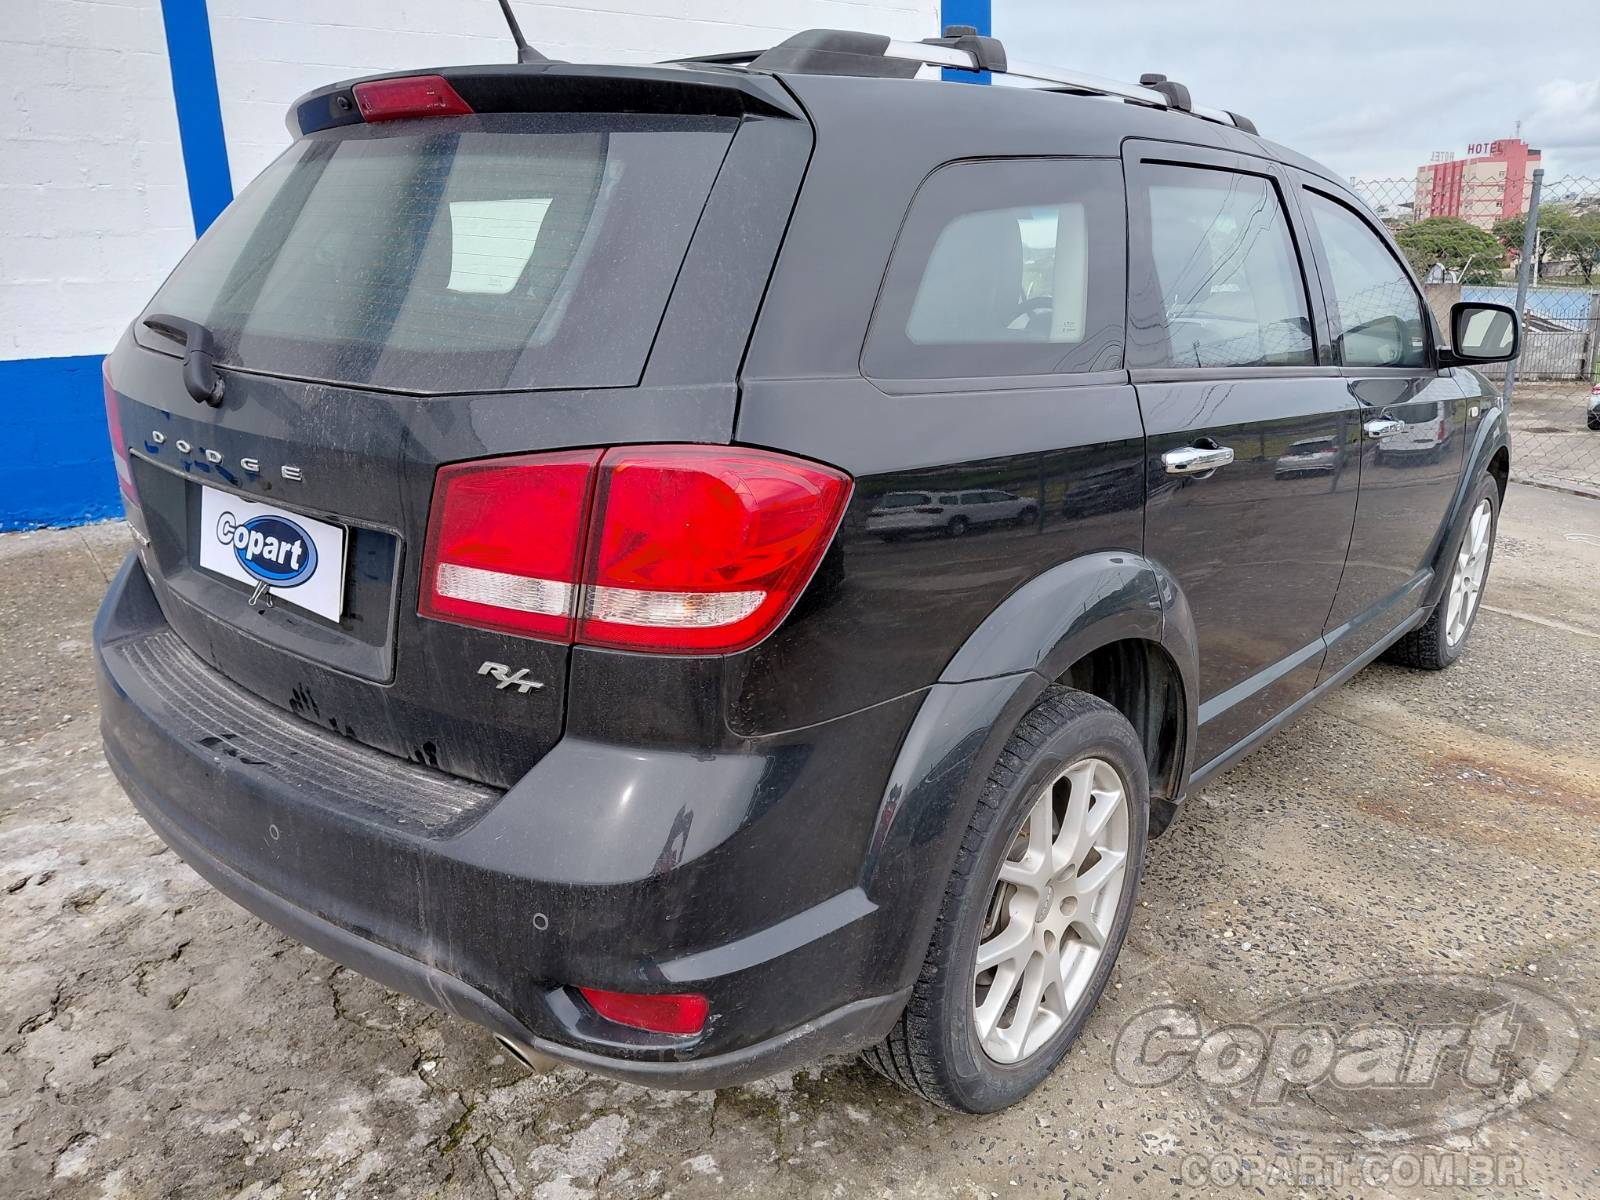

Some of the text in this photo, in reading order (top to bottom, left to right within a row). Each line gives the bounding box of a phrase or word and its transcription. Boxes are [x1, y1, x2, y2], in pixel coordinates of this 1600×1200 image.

[1467, 142, 1503, 155] HOTEL
[152, 430, 302, 481] DODGE
[216, 511, 302, 570] Copart
[477, 661, 544, 693] R/T
